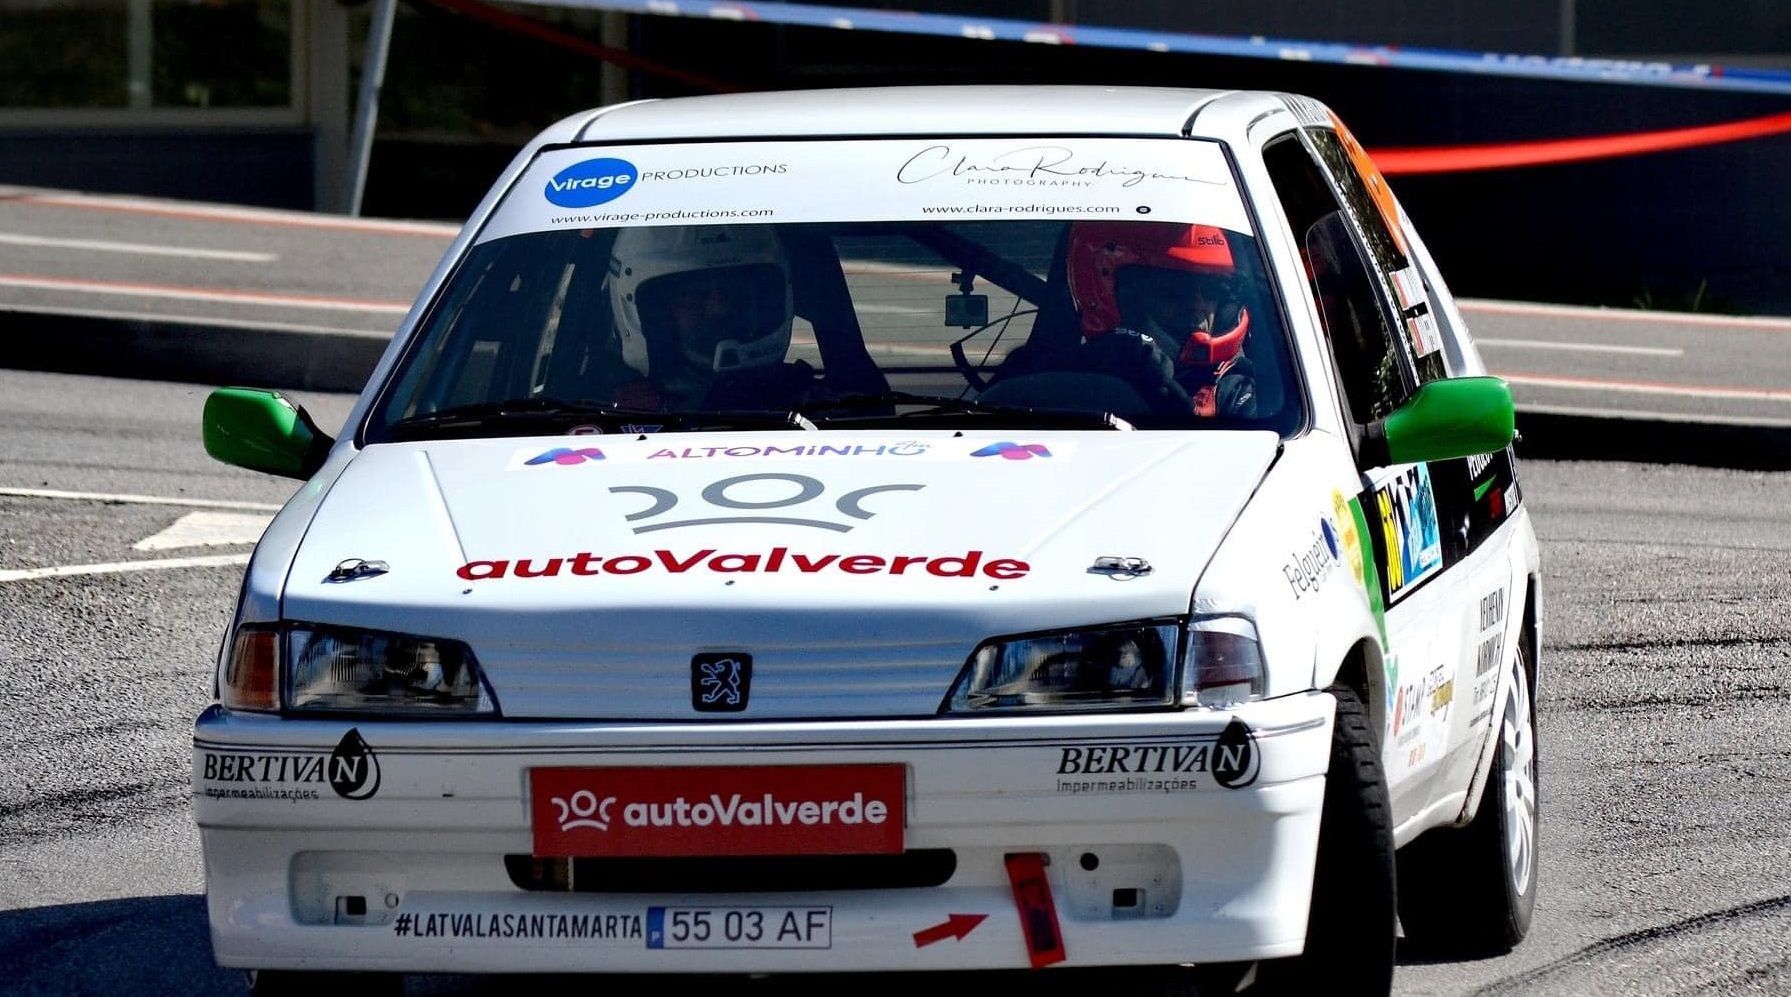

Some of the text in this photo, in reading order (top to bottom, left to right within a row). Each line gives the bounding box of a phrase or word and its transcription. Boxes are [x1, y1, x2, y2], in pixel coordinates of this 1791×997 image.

[641, 163, 788, 182] PRODUCTIONS
[967, 178, 1092, 188] PHOTOGRAPHY
[551, 209, 774, 224] www.virage-productions.com
[922, 203, 1121, 214] www.clara-rodrigues.com
[456, 547, 1031, 581] autoValverde
[203, 753, 362, 783] BERTIVAN
[1056, 745, 1246, 774] BERTIVAN
[623, 792, 888, 827] autoValverde
[394, 913, 642, 938] #LATVALASANTAMARTA
[672, 911, 712, 941] 55
[724, 911, 764, 941] 03
[776, 911, 827, 941] AF
